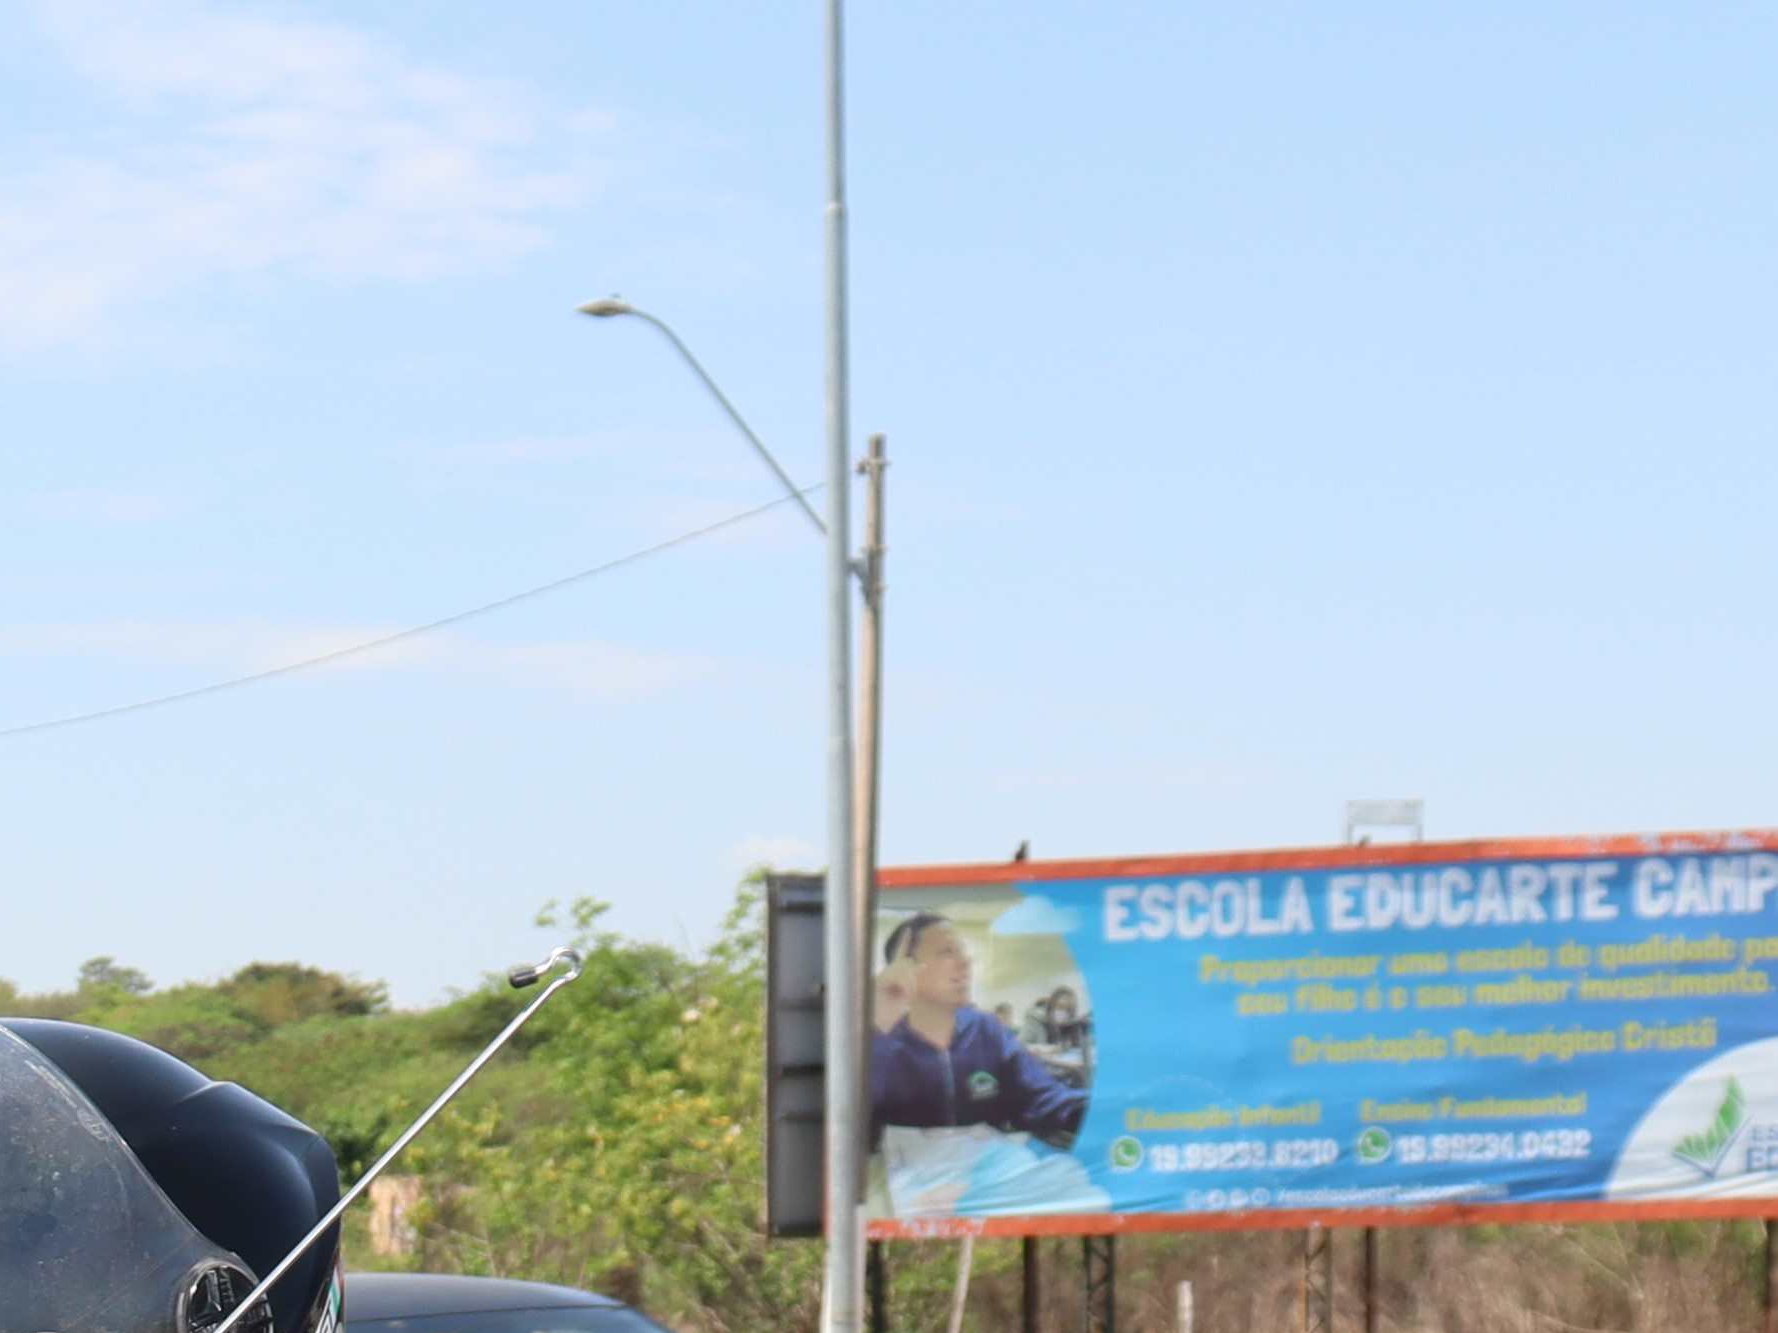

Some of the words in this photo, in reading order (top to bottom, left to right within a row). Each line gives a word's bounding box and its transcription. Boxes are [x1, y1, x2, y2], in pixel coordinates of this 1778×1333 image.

[1102, 876, 1314, 943] ESCOLA
[1327, 860, 1620, 933] EDUCARTE
[1199, 951, 1382, 988] Proporcionar
[1456, 940, 1549, 973] escola
[1557, 938, 1590, 968] de
[1599, 933, 1735, 971] qualidade
[1236, 993, 1289, 1016] seu
[1294, 983, 1358, 1012] filho
[1415, 984, 1468, 1007] seu
[1474, 973, 1574, 1004] melhor
[1291, 1030, 1445, 1065] Orientação
[1452, 1027, 1616, 1063] Pedagógica
[1622, 1017, 1717, 1051] Cristã
[1125, 1104, 1232, 1133] Educação
[1360, 1098, 1433, 1123] Ensino
[1437, 1092, 1587, 1118] Fundamental
